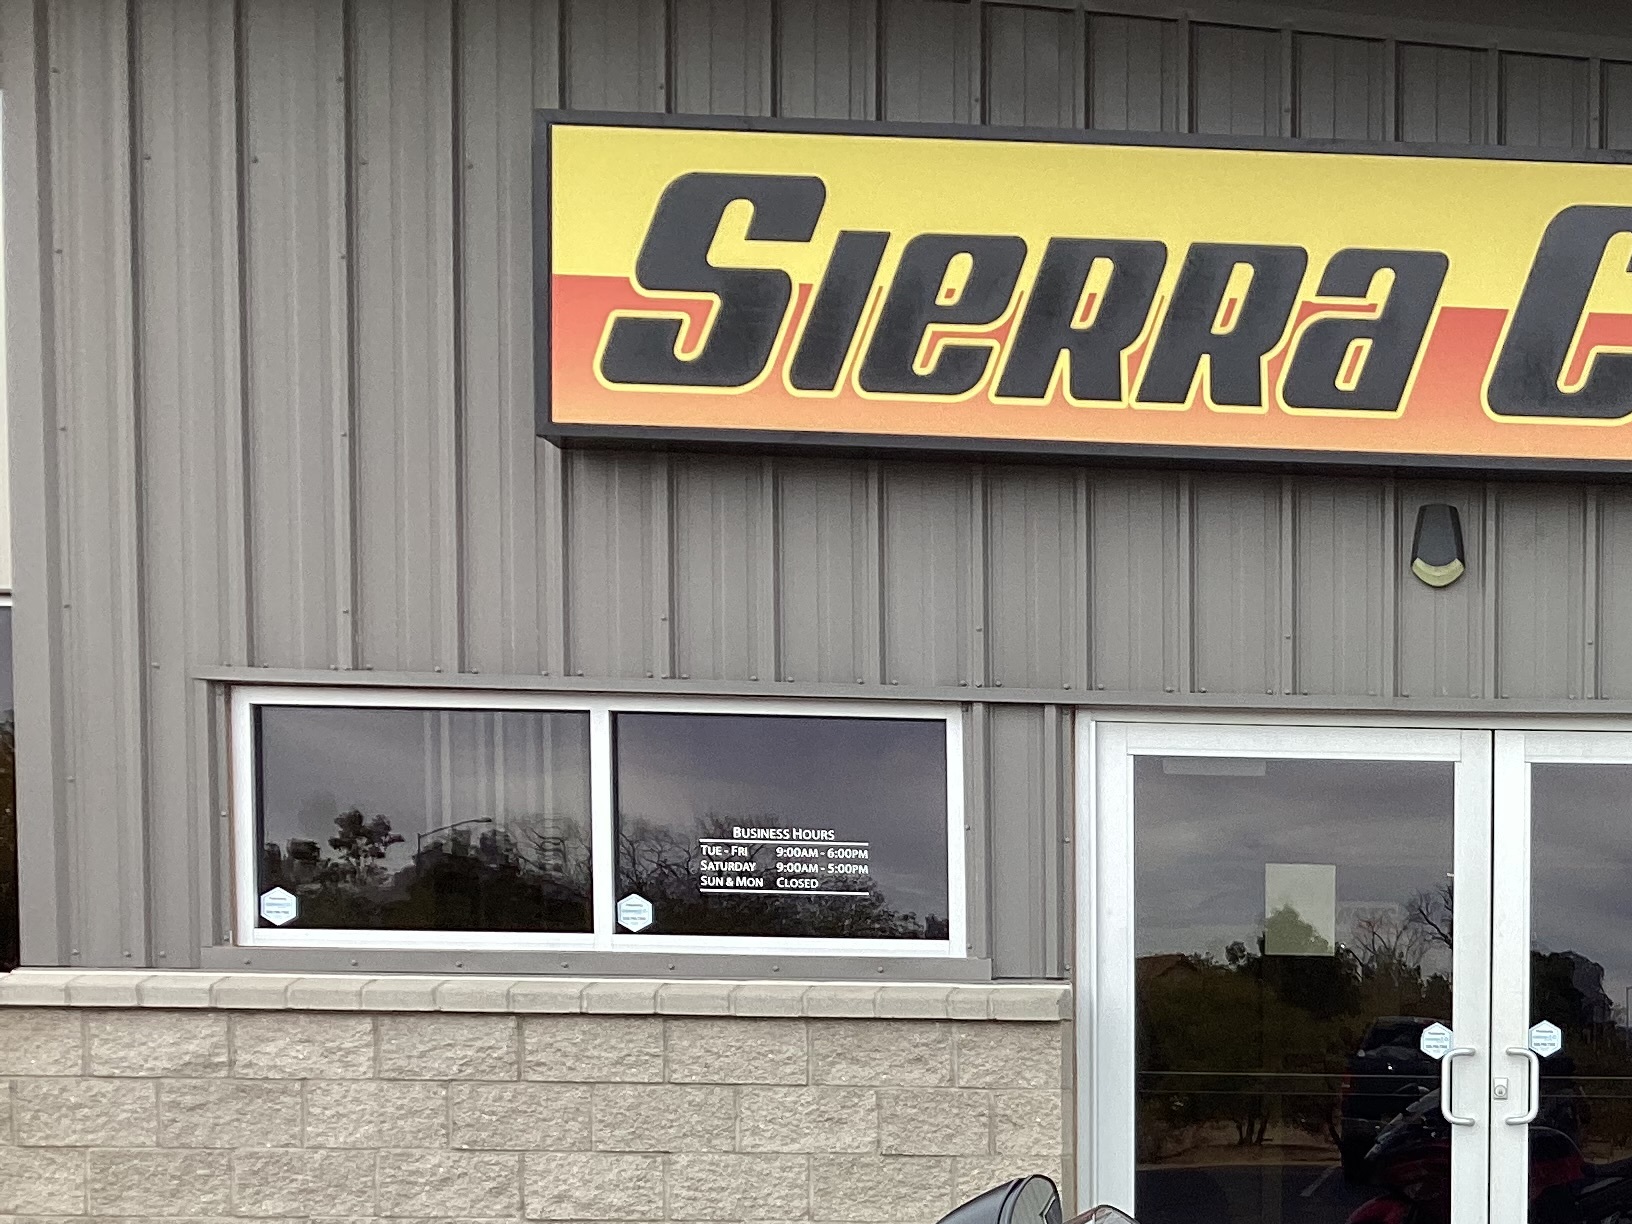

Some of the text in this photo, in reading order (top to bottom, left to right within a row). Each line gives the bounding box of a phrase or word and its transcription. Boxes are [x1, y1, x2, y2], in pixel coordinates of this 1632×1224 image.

[775, 846, 819, 858] 9:00AM
[826, 847, 869, 860] 6:00PM
[775, 861, 819, 874] 9:00AM
[826, 862, 869, 875] 5:00PM
[725, 877, 734, 887] &
